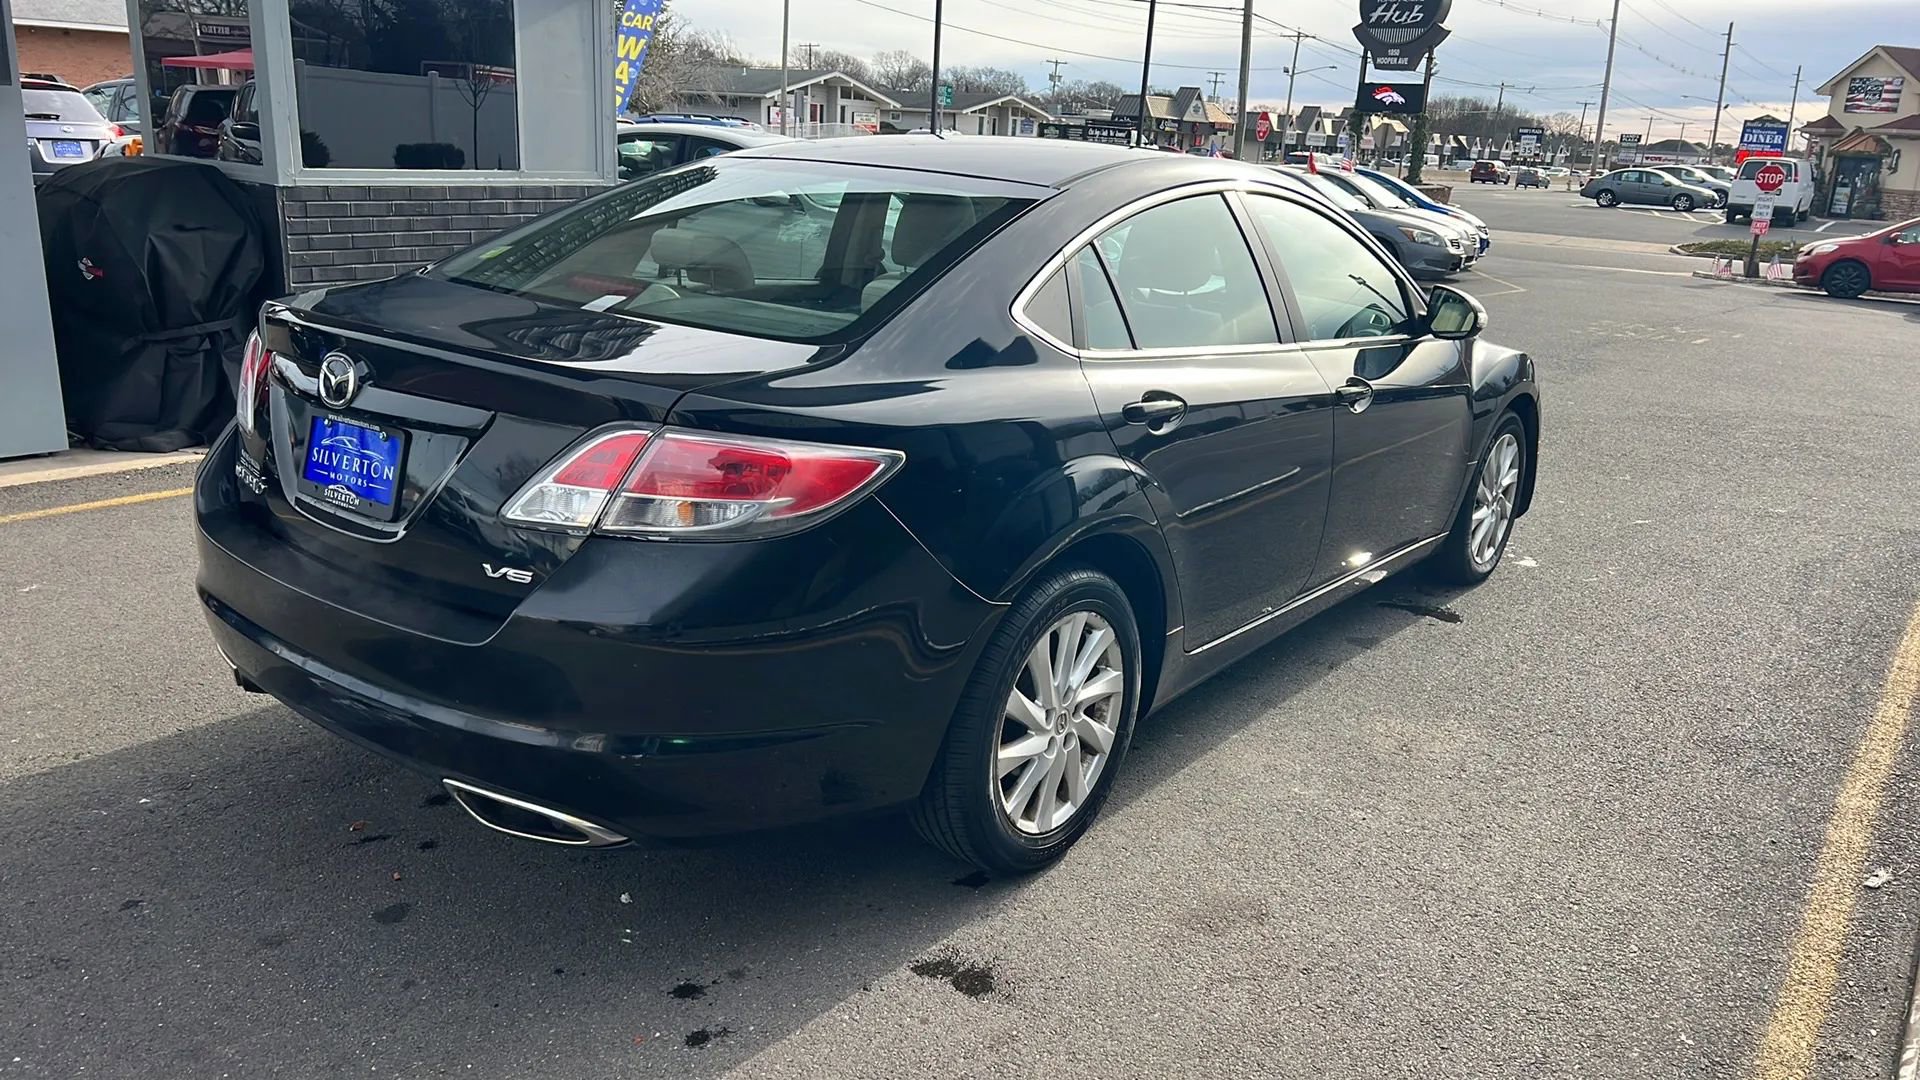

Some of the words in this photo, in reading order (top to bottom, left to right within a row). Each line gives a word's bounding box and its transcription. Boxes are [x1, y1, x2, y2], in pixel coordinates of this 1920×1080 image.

[621, 11, 653, 31] CAR
[1369, 3, 1424, 24] Hub
[1377, 57, 1398, 65] HOOPER
[1743, 134, 1783, 144] DINER
[1756, 173, 1784, 184] STOP
[312, 447, 394, 481] SILVERTON
[329, 471, 367, 488] MOTORS
[324, 488, 360, 506] SILVERTON
[482, 563, 534, 584] V6
